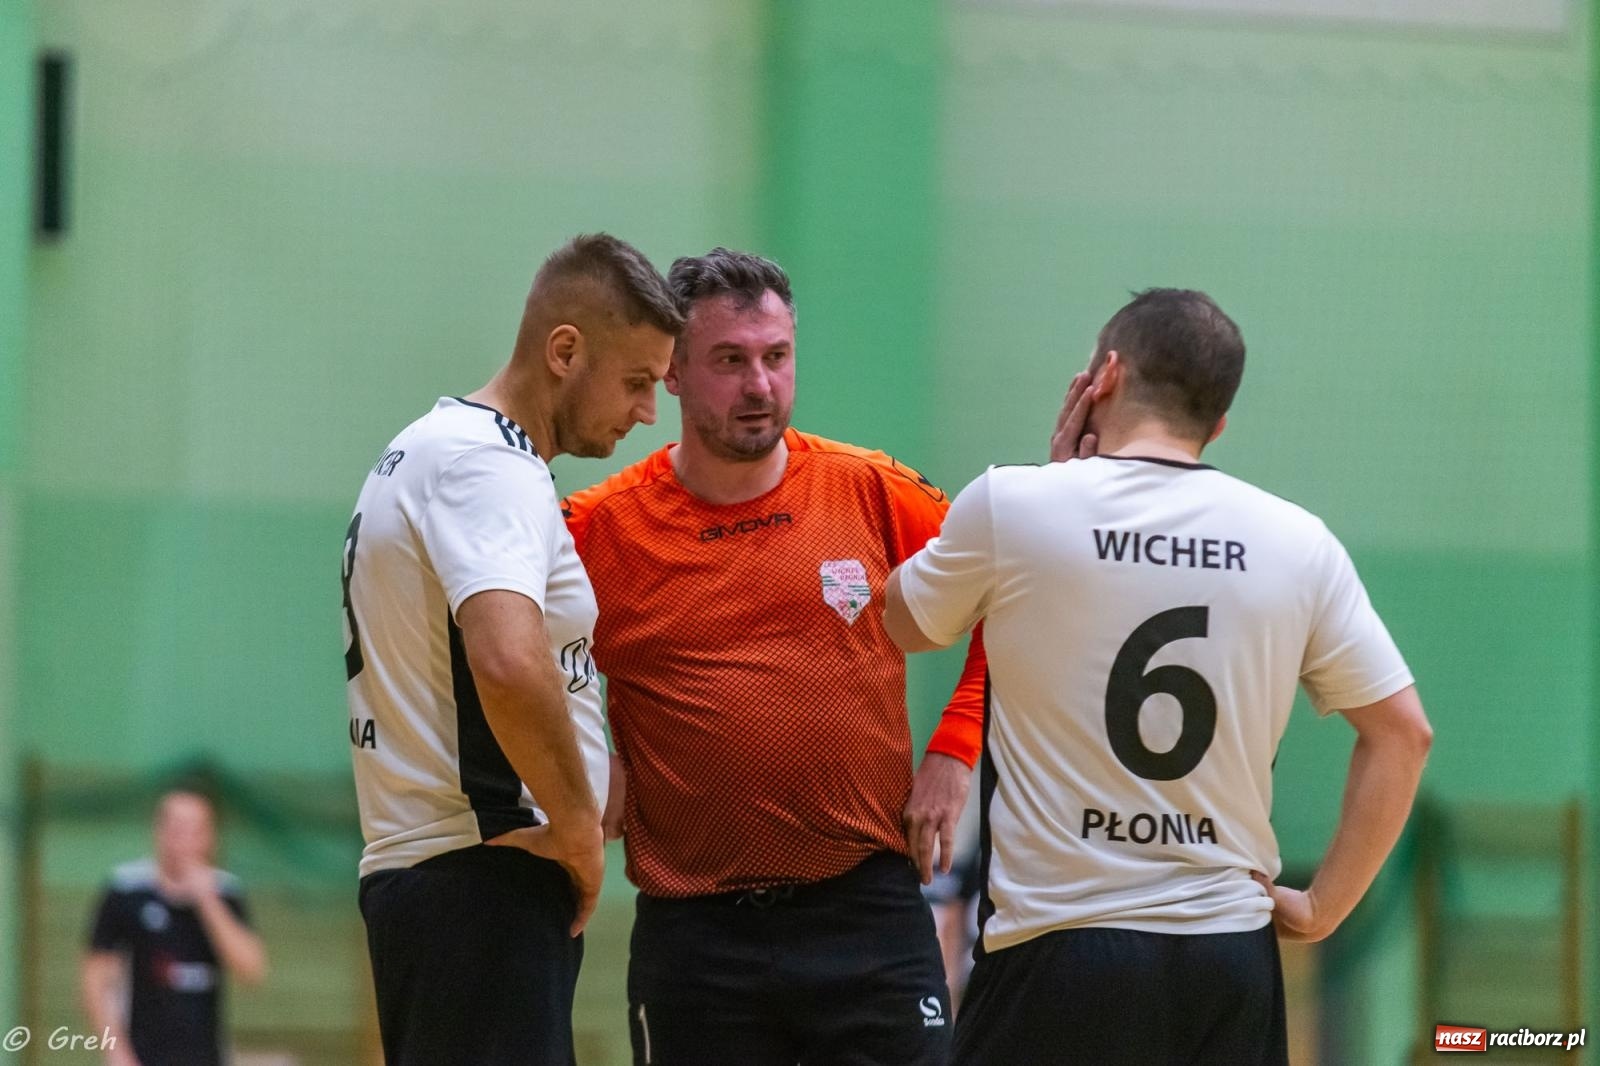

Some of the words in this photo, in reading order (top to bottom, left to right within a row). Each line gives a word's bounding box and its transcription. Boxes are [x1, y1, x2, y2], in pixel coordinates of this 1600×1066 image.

[700, 513, 793, 542] GIVOVA
[1093, 528, 1247, 571] WICHER
[1105, 605, 1217, 781] 6
[1081, 808, 1218, 845] PŁONIA
